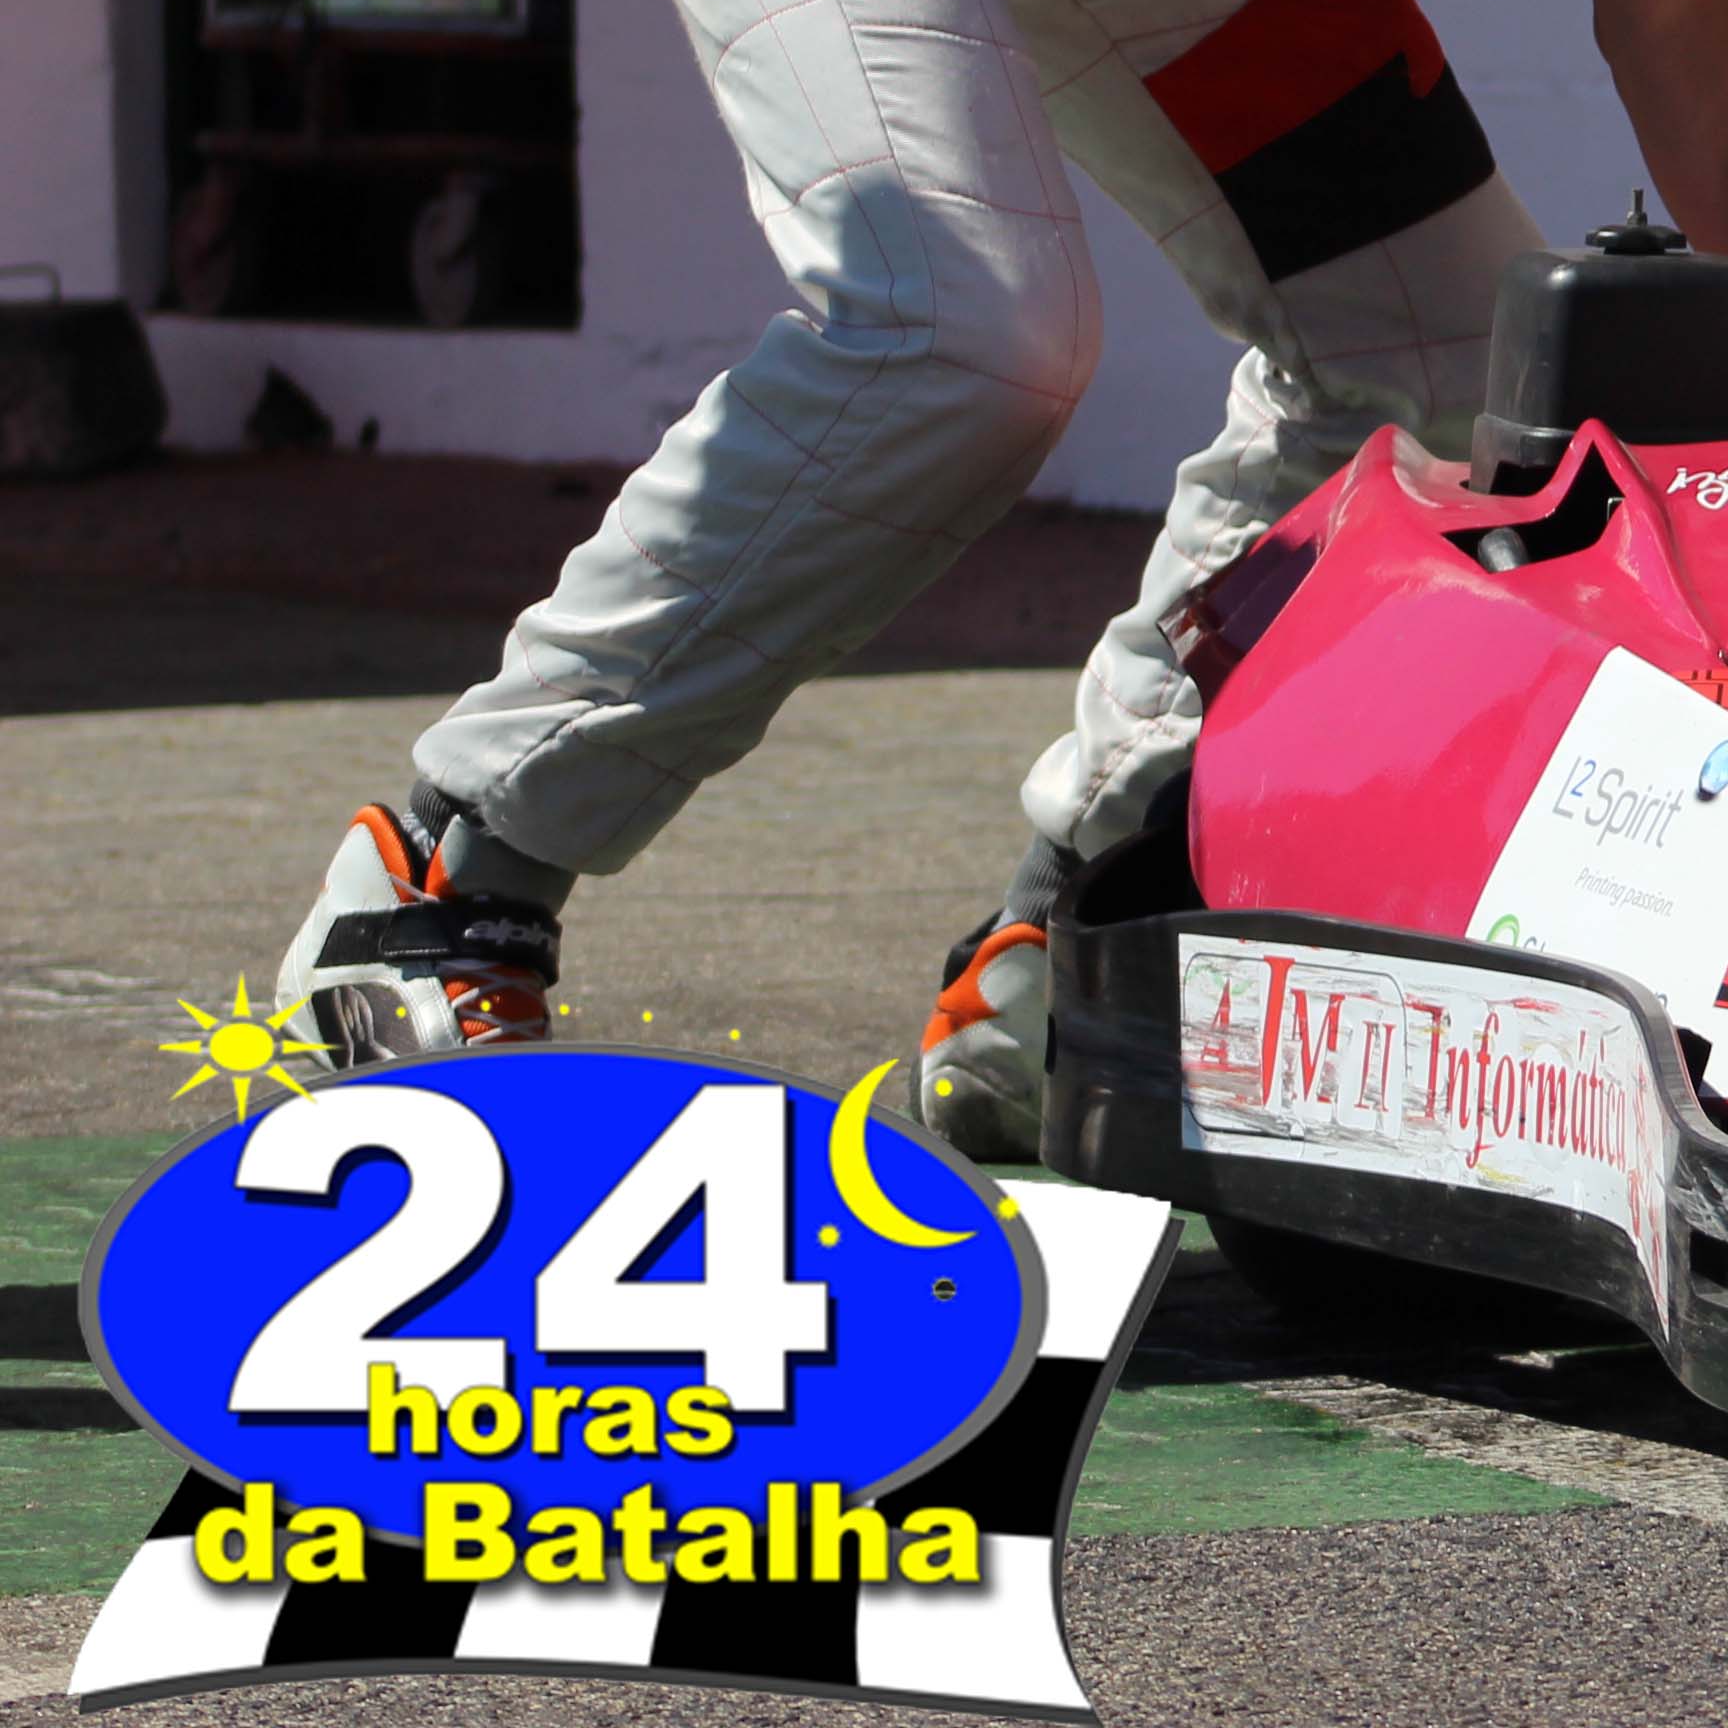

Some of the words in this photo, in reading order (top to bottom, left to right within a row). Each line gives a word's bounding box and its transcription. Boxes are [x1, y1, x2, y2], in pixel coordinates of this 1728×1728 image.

[1584, 767, 1686, 850] Spirit
[1574, 866, 1627, 907] Printing
[1404, 996, 1627, 1172] Informática
